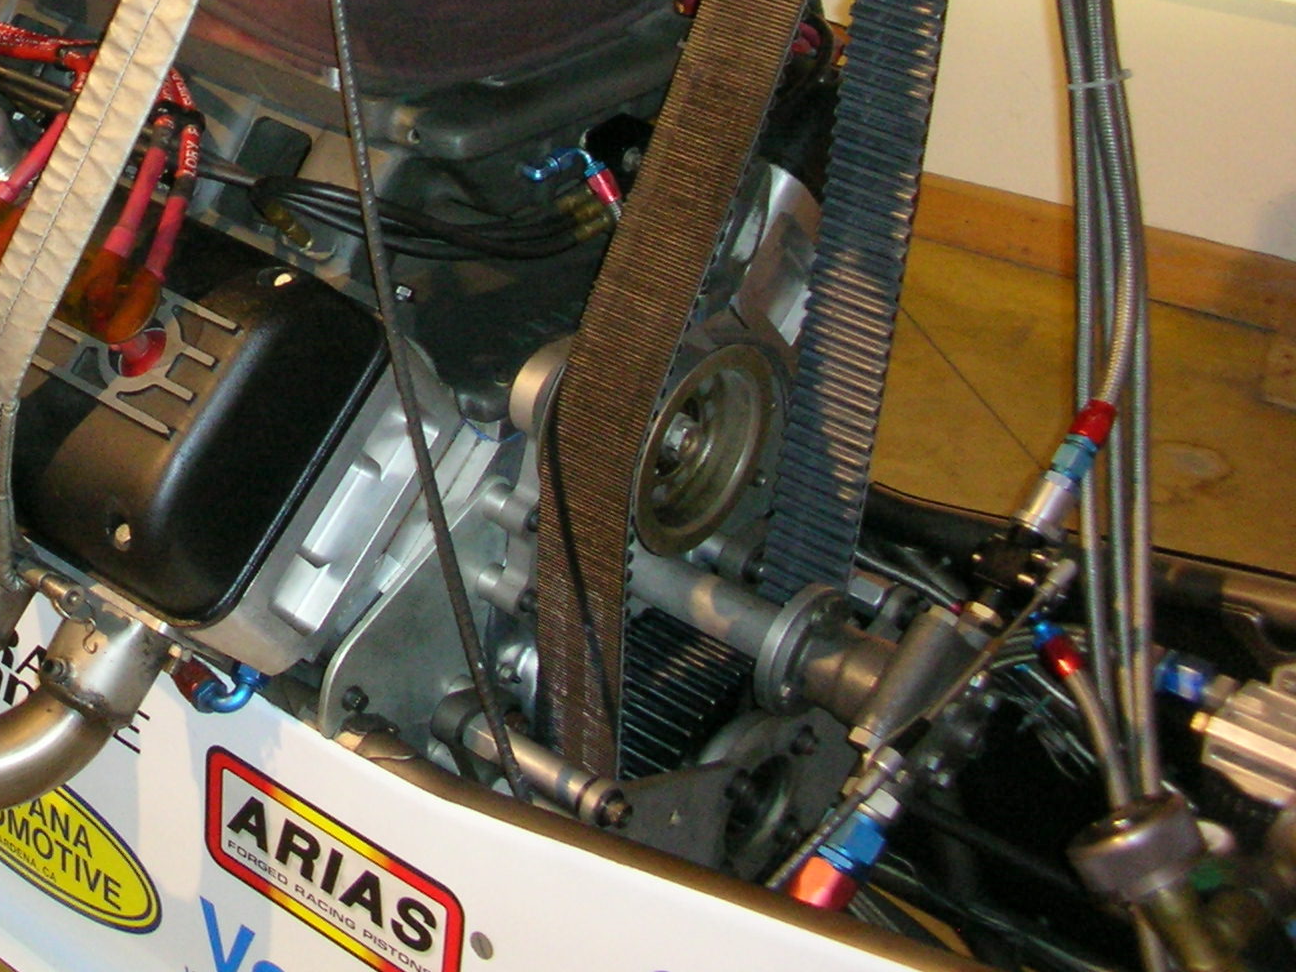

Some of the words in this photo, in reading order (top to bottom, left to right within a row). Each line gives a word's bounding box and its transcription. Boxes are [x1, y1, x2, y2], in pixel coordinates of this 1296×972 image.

[26, 796, 94, 859] ANA
[226, 795, 438, 953] ARIAS
[227, 839, 289, 886] FORGED
[294, 883, 357, 931] RACING
[362, 928, 433, 972] PISTON
